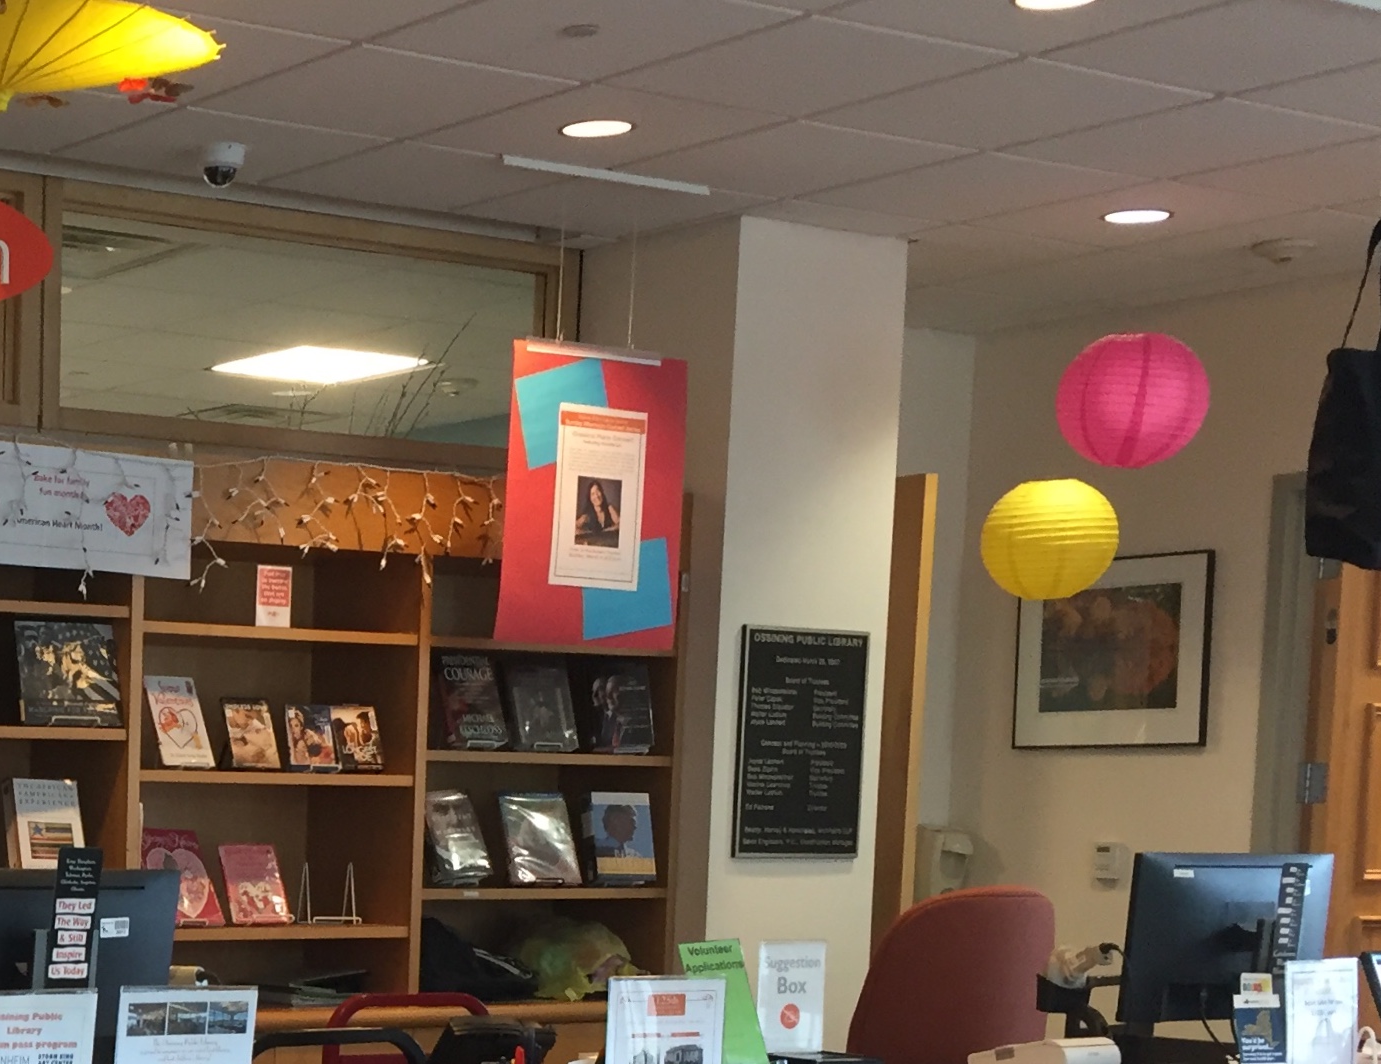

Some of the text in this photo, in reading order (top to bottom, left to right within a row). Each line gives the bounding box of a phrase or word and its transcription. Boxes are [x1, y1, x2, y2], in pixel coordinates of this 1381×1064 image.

[796, 635, 826, 646] PUBLIC
[58, 900, 92, 911] They Led
[57, 917, 89, 928] The Way
[68, 933, 84, 942] Still
[56, 950, 83, 960] Inspire
[686, 943, 733, 956] Volunteer
[685, 959, 744, 974] Applications
[764, 956, 821, 972] Suggestion
[51, 965, 85, 975] Us Today
[777, 977, 807, 994] Box
[32, 1012, 63, 1021] Public
[6, 1026, 42, 1036] Library
[11, 1041, 33, 1050] pass
[35, 1041, 77, 1051] program
